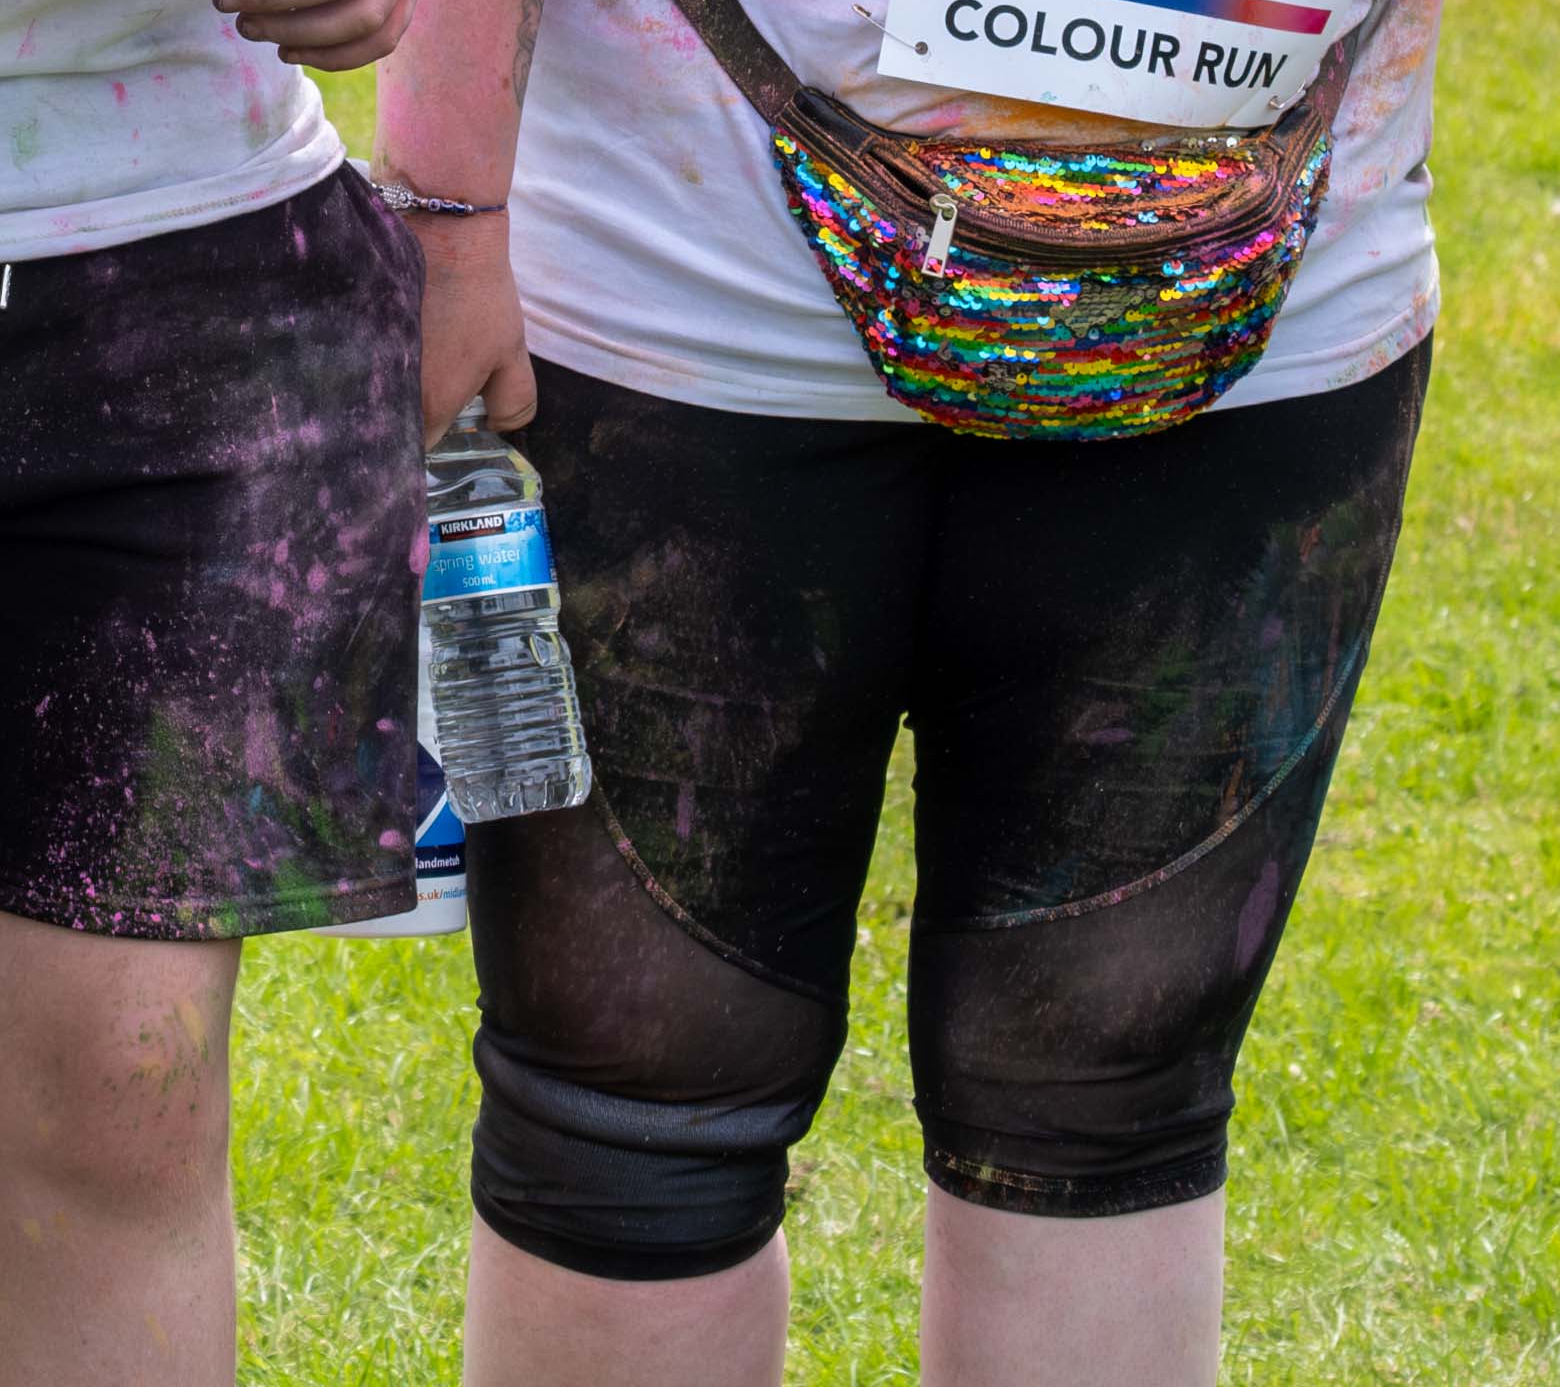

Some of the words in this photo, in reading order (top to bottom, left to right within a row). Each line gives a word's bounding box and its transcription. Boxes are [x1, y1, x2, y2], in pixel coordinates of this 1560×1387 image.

[1193, 40, 1289, 90] RUN
[441, 516, 502, 535] KIRKLAND
[433, 554, 474, 575] spring
[479, 548, 520, 566] water
[463, 576, 480, 588] 500
[416, 856, 459, 869] landmetuh
